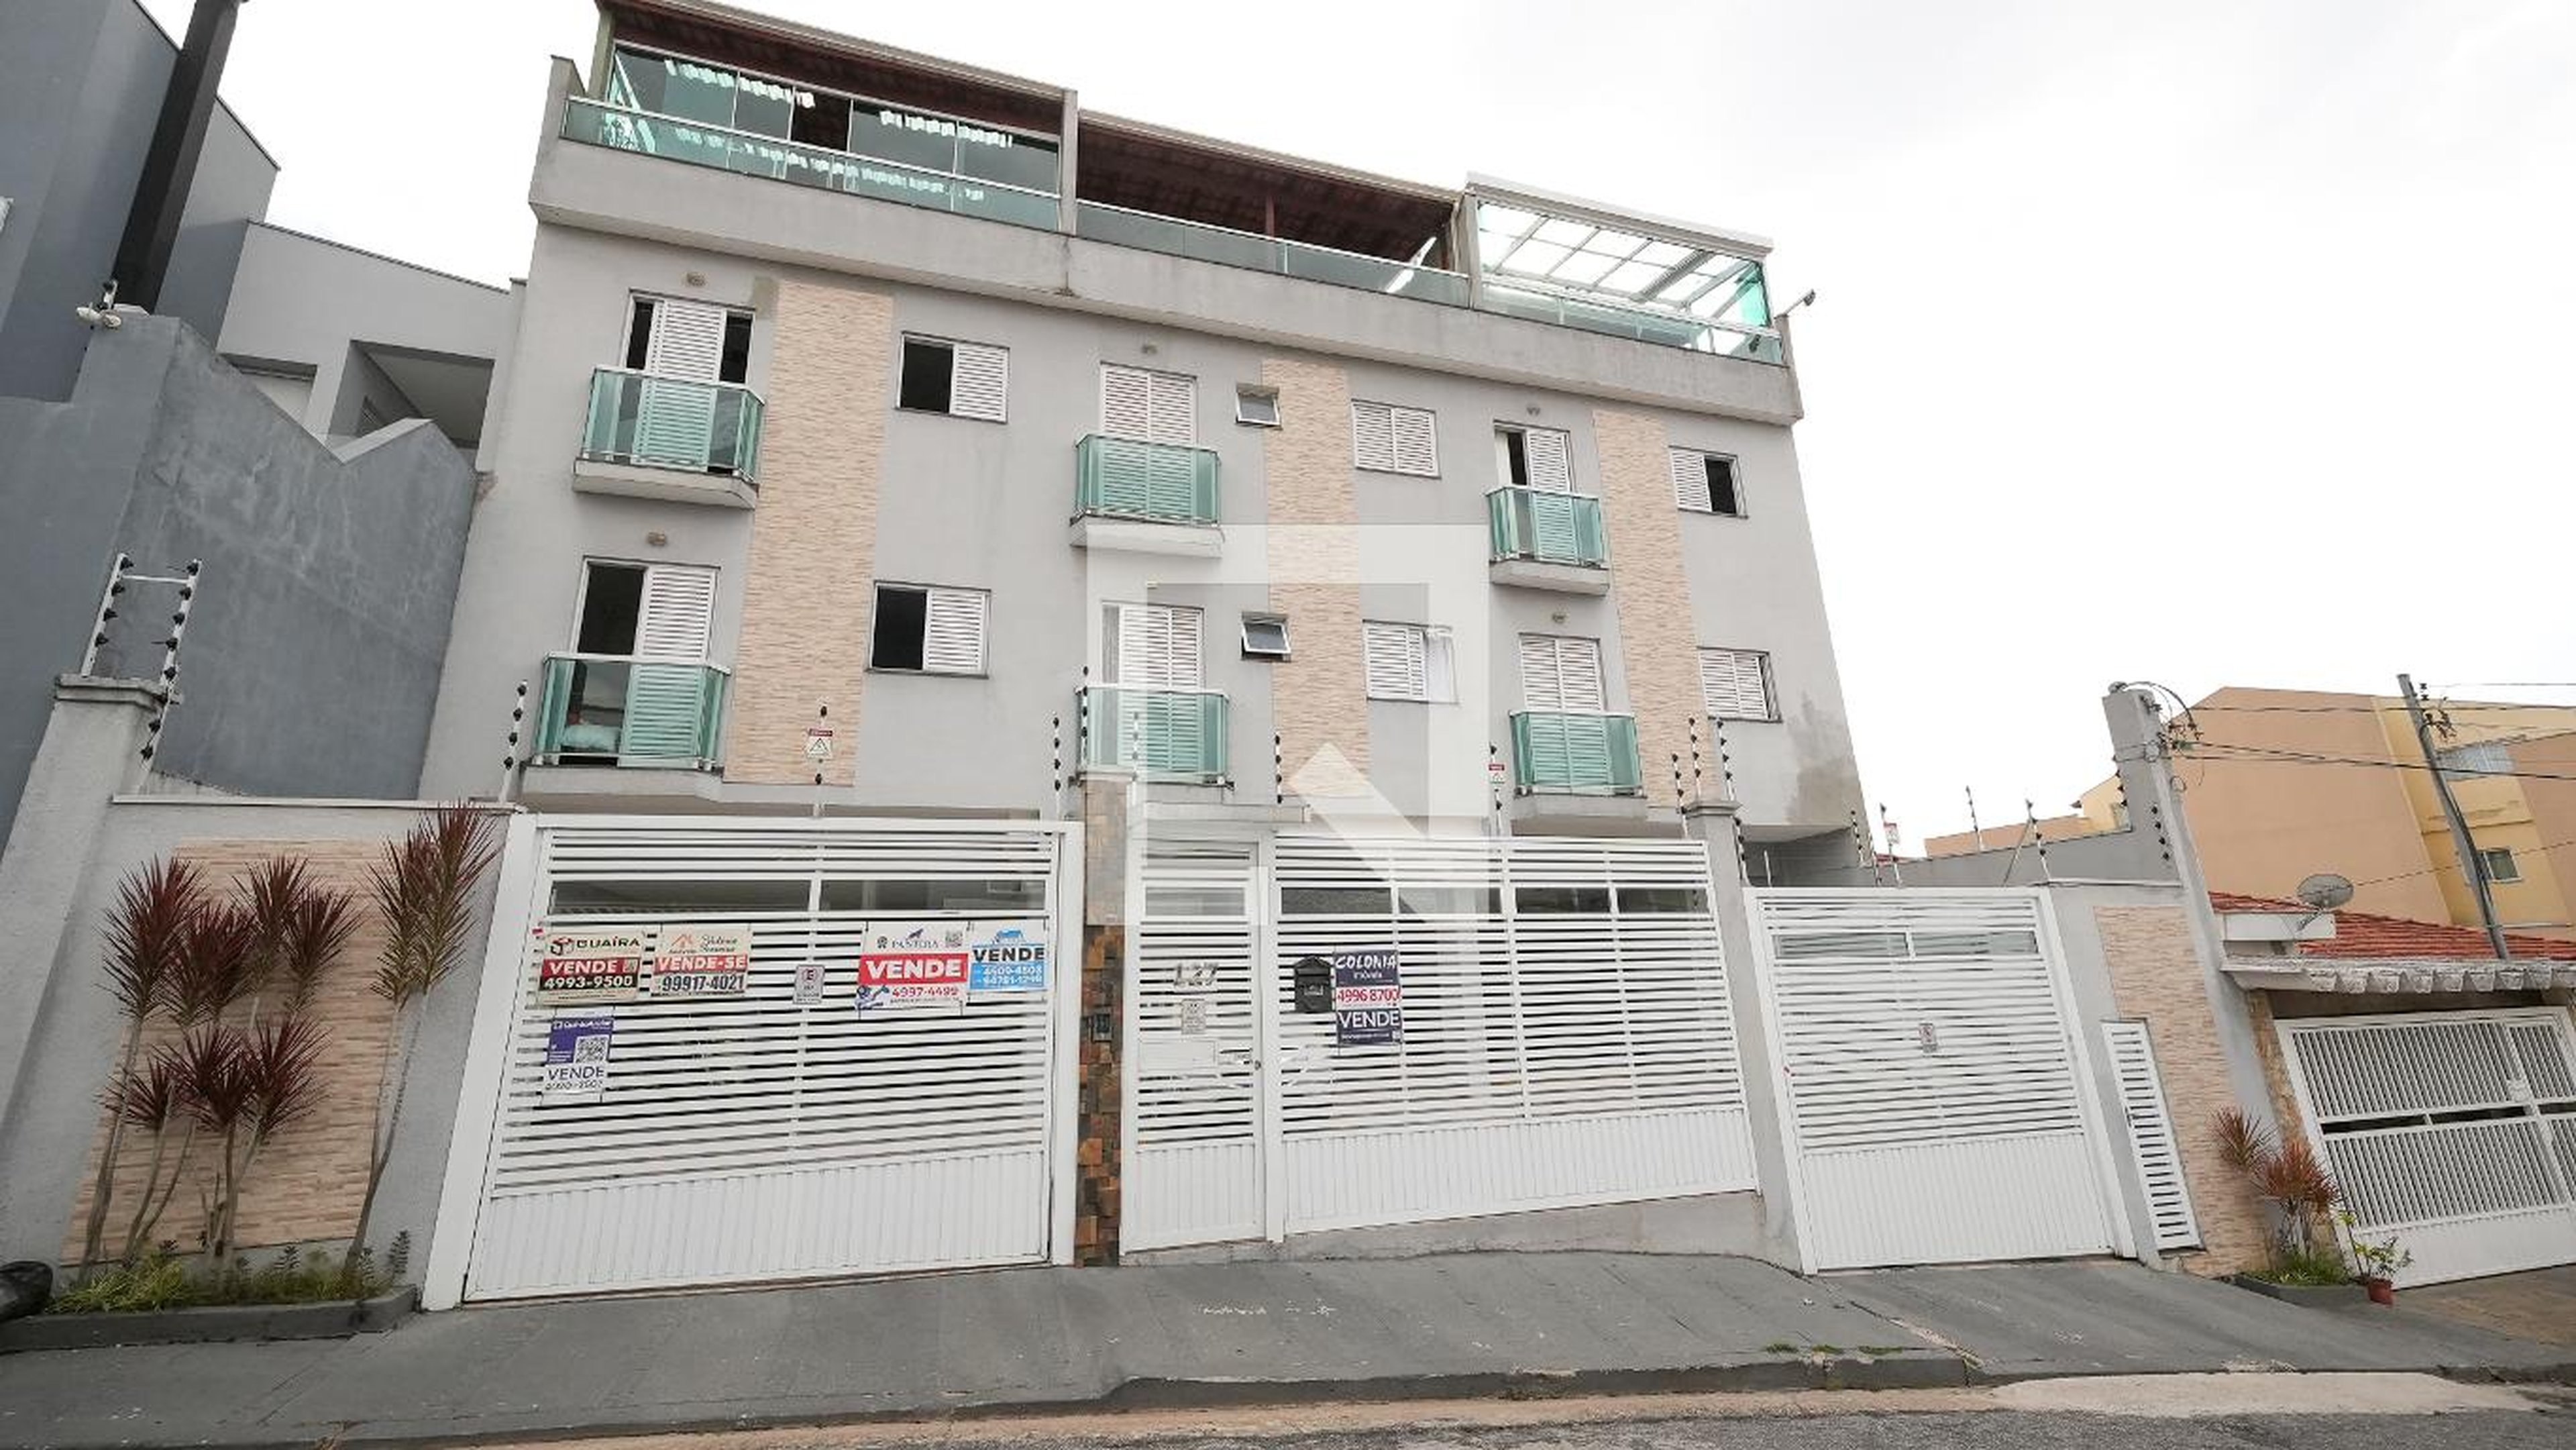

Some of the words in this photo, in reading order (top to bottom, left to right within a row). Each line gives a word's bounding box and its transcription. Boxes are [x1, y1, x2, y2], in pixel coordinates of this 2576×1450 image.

[657, 953, 747, 972] VENDE-SE
[973, 947, 1044, 962] VENDE
[549, 960, 619, 975] VENDE
[865, 959, 962, 979] VENDE
[544, 975, 633, 989] 4993-9500
[662, 974, 745, 992] 99917-4021
[1337, 1011, 1401, 1028] VENDE
[548, 1066, 604, 1081] VENDE
